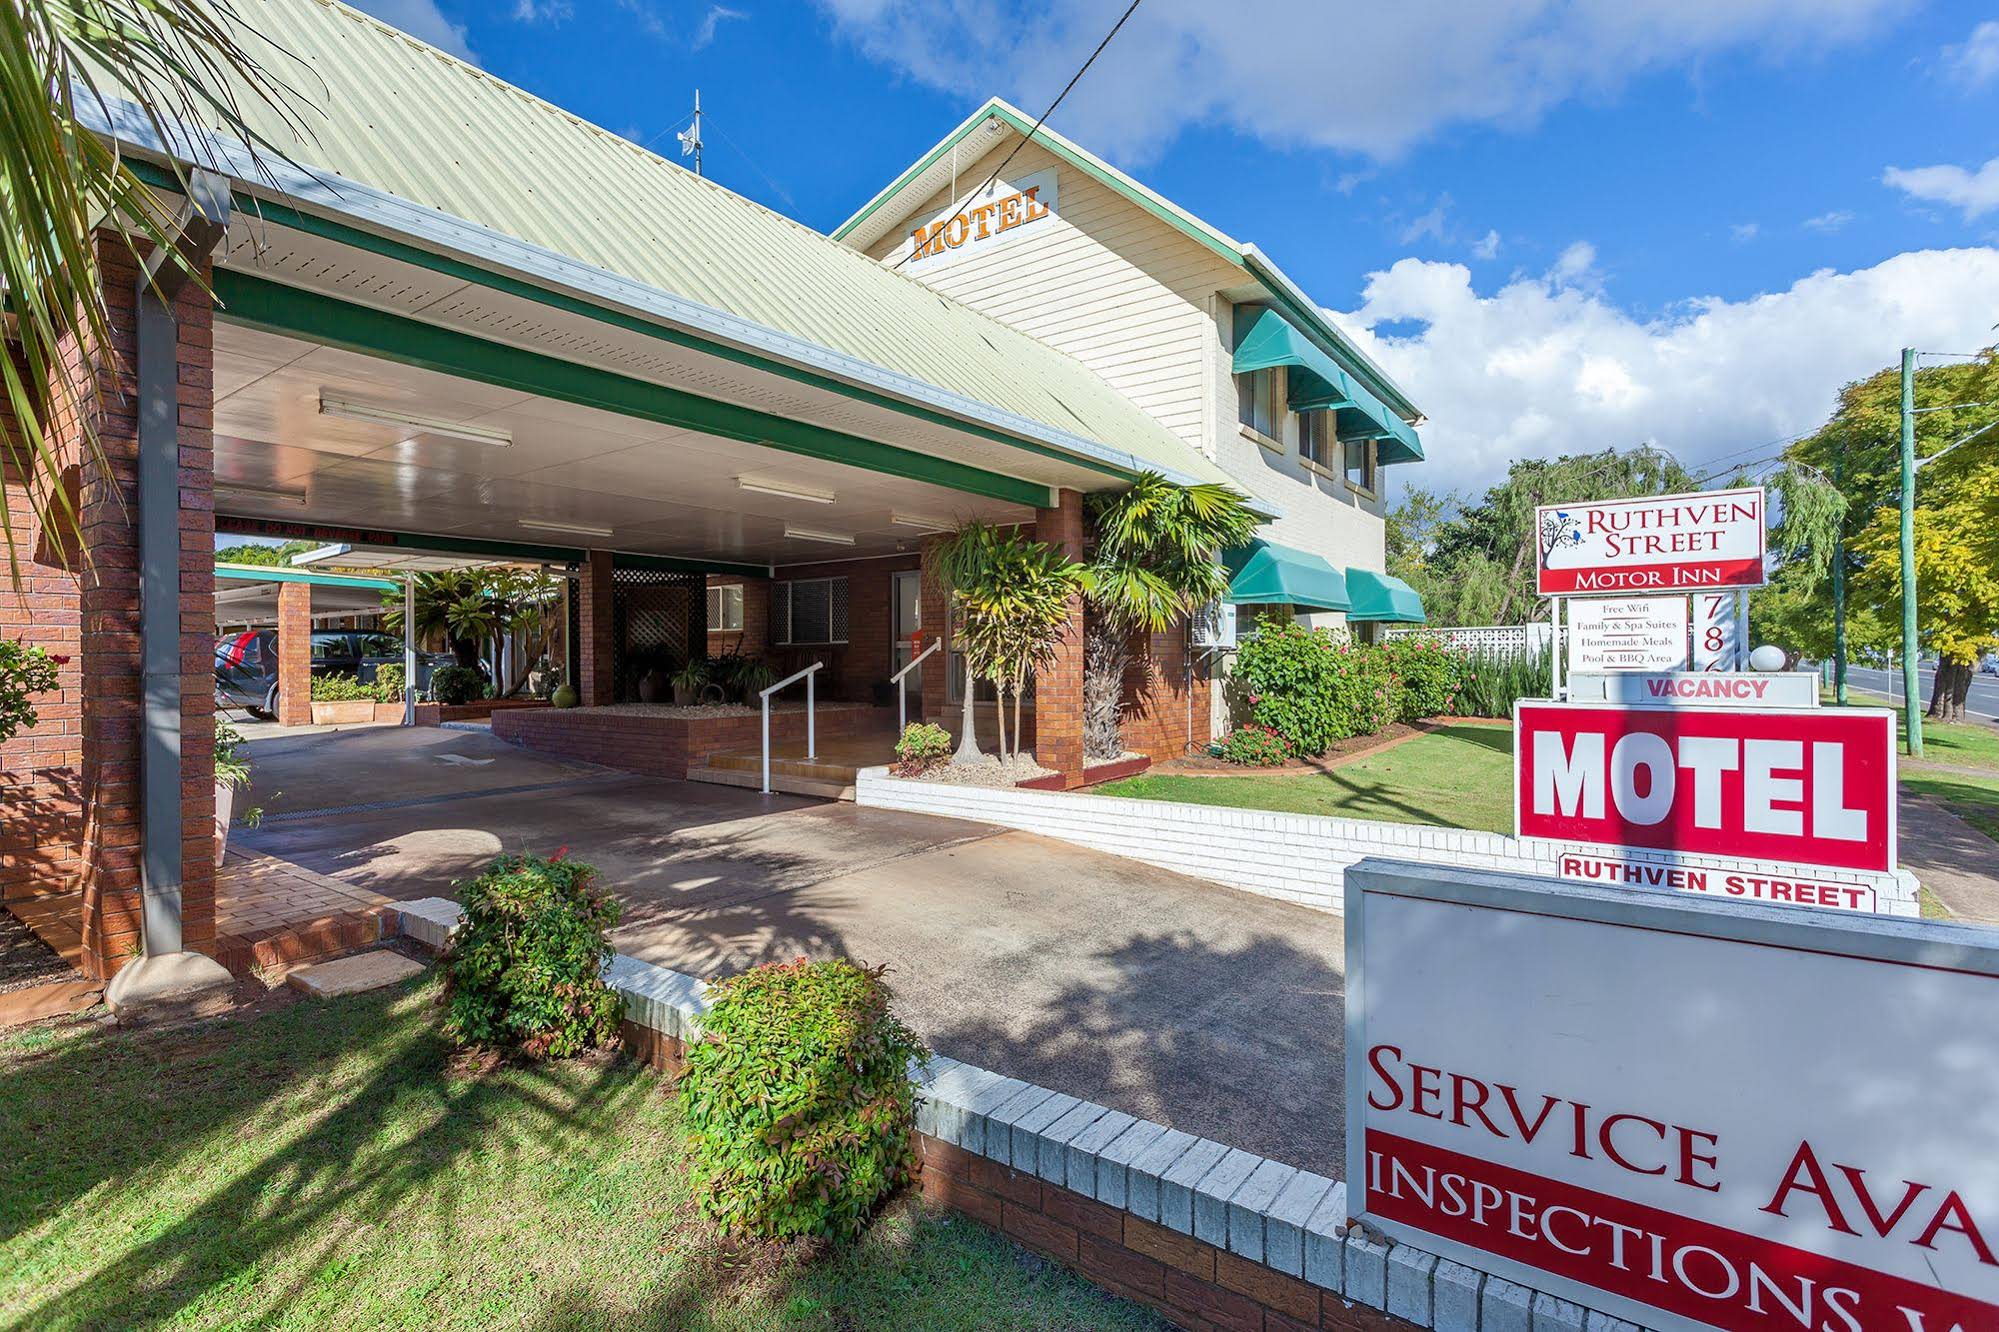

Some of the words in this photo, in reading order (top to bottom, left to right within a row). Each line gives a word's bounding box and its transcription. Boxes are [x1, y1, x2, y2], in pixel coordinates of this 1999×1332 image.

[910, 185, 1049, 262] MOTEL
[1587, 501, 1757, 534] RUTHVEN
[1605, 530, 1726, 558] STREET
[1575, 570, 1665, 590] MOTOR
[1673, 566, 1721, 585] INN
[1602, 604, 1624, 614] Free
[1627, 603, 1649, 612] Wifi
[1577, 621, 1609, 632] Family
[1612, 621, 1622, 630] &
[1624, 621, 1643, 631] Spa
[1647, 620, 1677, 630] Suites
[1581, 637, 1639, 647] Homemade
[1642, 636, 1673, 647] Meals
[1582, 653, 1604, 663] Pool
[1607, 654, 1616, 663] &
[1619, 653, 1645, 664] BBQ
[1648, 653, 1672, 663] Area
[1647, 679, 1769, 699] VACANCY
[1533, 730, 1868, 842] MOTEL
[1563, 857, 1707, 891] RUTHVEN
[1725, 876, 1866, 909] STREET
[1367, 1044, 1721, 1193] SERVICE
[1369, 1151, 1862, 1332] INSPECTIONS
